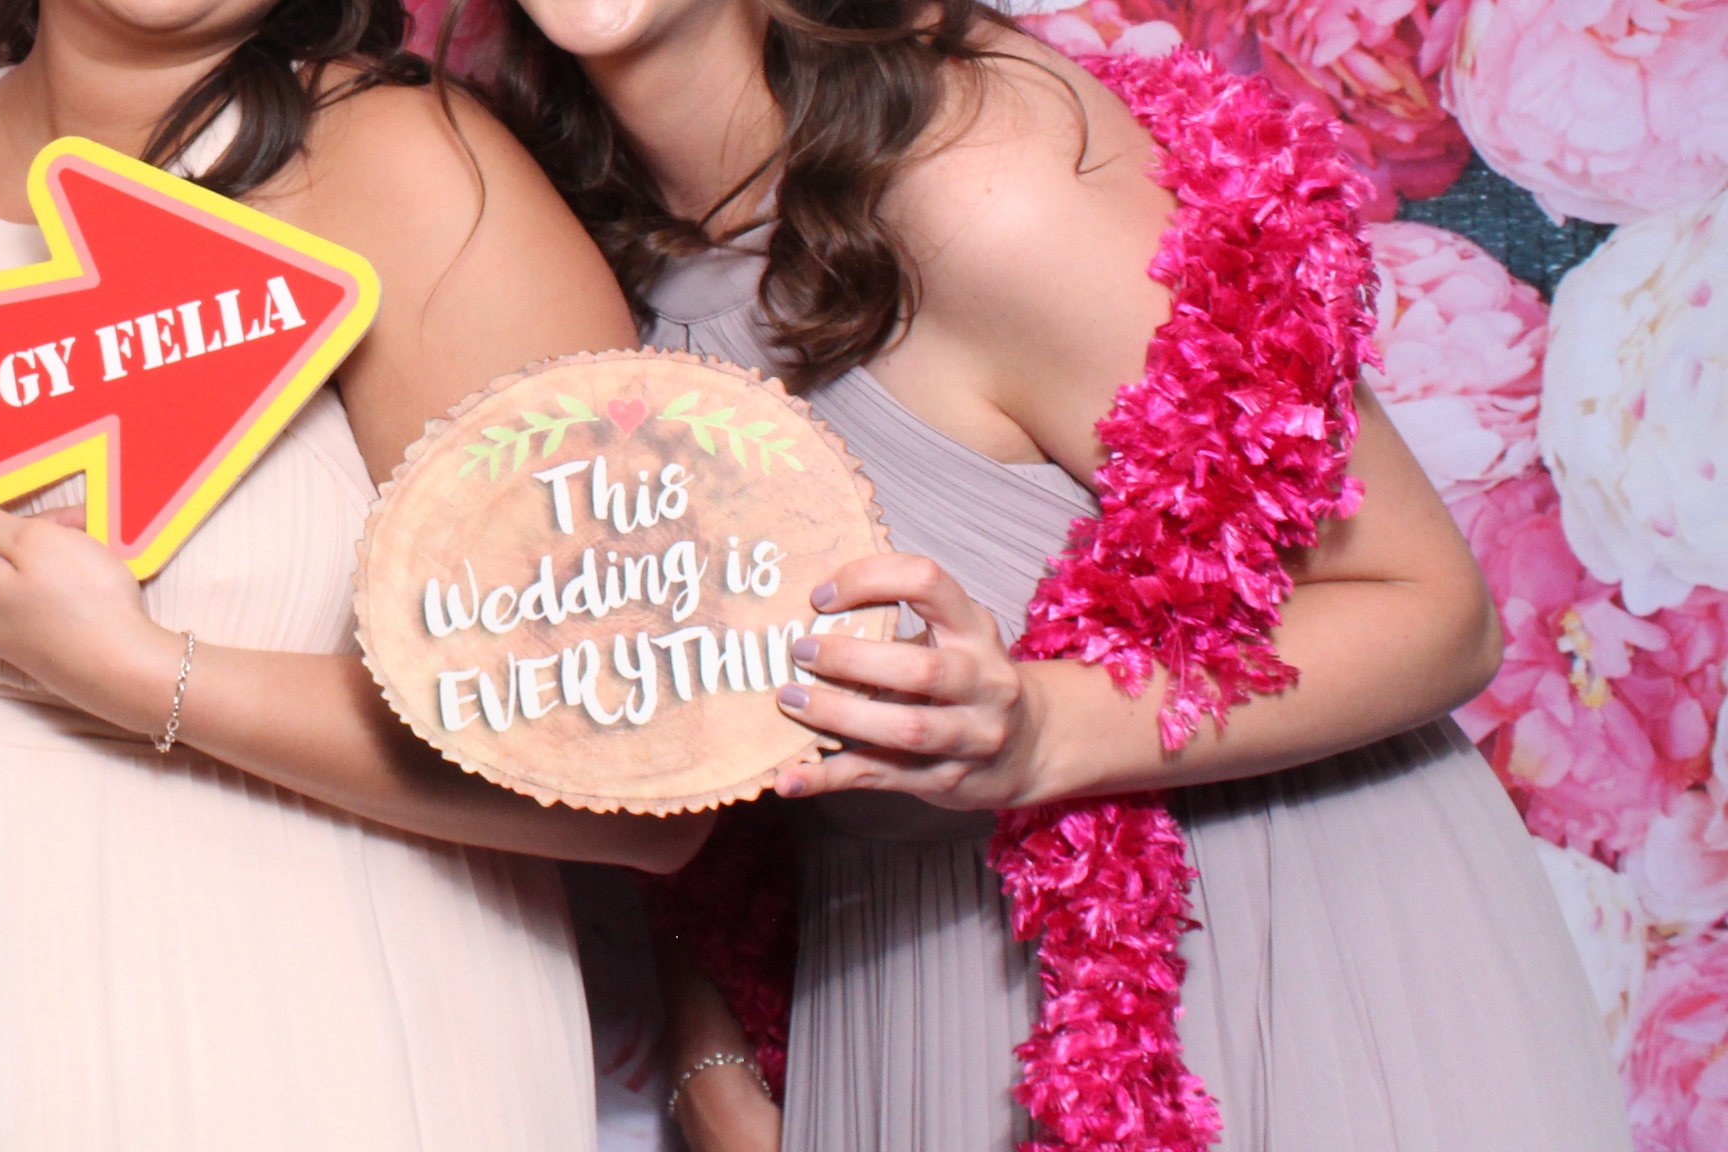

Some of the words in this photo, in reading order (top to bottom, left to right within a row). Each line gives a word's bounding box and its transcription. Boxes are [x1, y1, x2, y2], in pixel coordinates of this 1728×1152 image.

[95, 275, 307, 382] FELLA
[531, 454, 695, 535] This
[423, 539, 709, 638] Wedding
[726, 535, 787, 598] is
